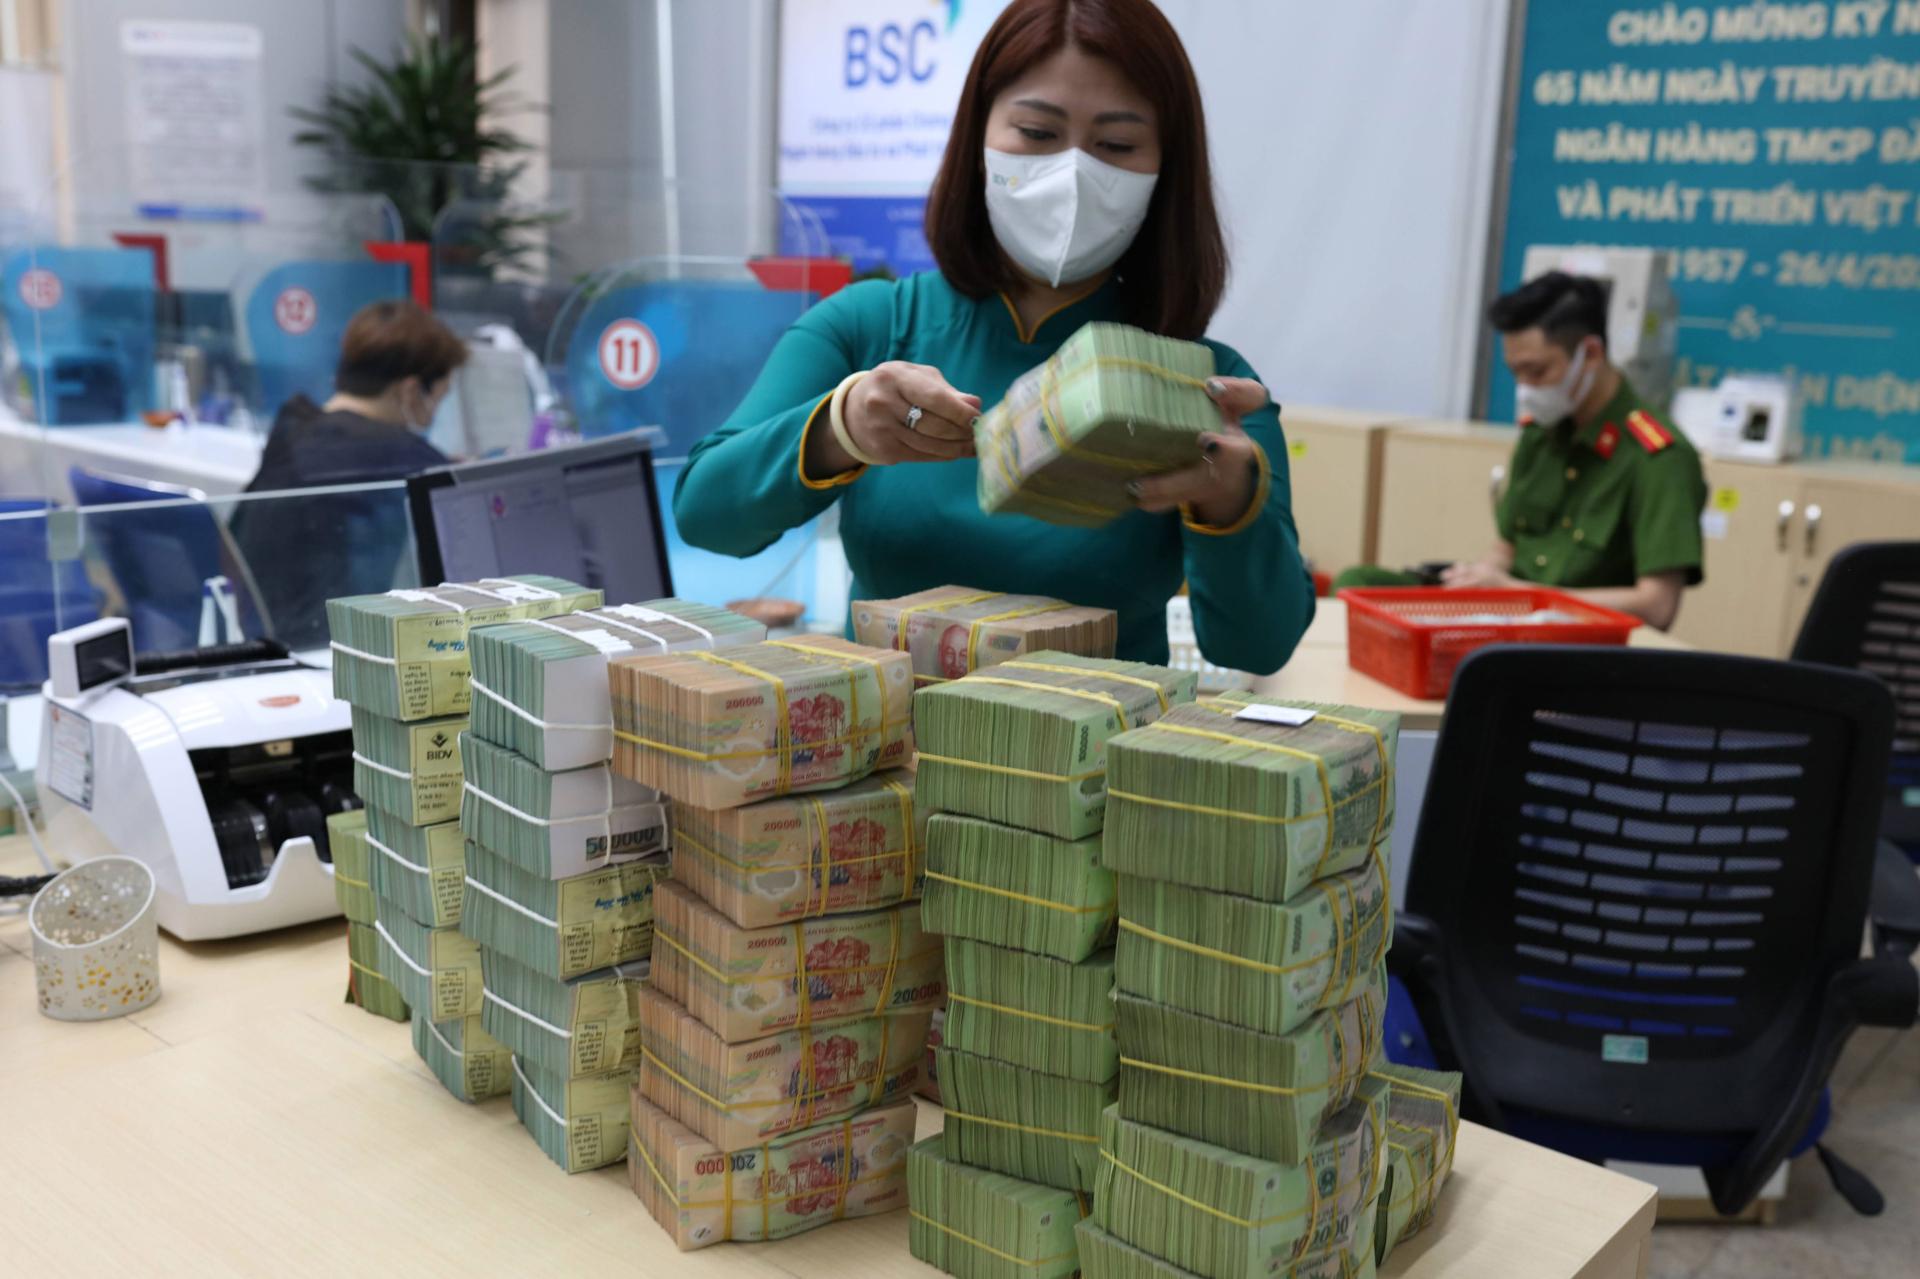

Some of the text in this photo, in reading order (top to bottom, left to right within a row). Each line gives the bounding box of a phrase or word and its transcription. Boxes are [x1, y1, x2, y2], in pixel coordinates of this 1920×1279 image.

[845, 19, 937, 89] BSC
[1533, 70, 1576, 105] 65
[1579, 64, 1661, 104] NĂM
[1664, 60, 1767, 104] NGÀY
[1554, 122, 1651, 162] NGÂN
[1655, 121, 1757, 163] HÀNG
[1764, 126, 1874, 165] TMCP
[1557, 179, 1603, 219] VÀ
[1607, 181, 1703, 222] PHÁT
[613, 337, 640, 374] 11
[725, 695, 765, 710] 200000
[426, 749, 453, 761] BIDV
[866, 738, 905, 766] 20000
[764, 817, 802, 832] 200000
[747, 935, 788, 949] 200000
